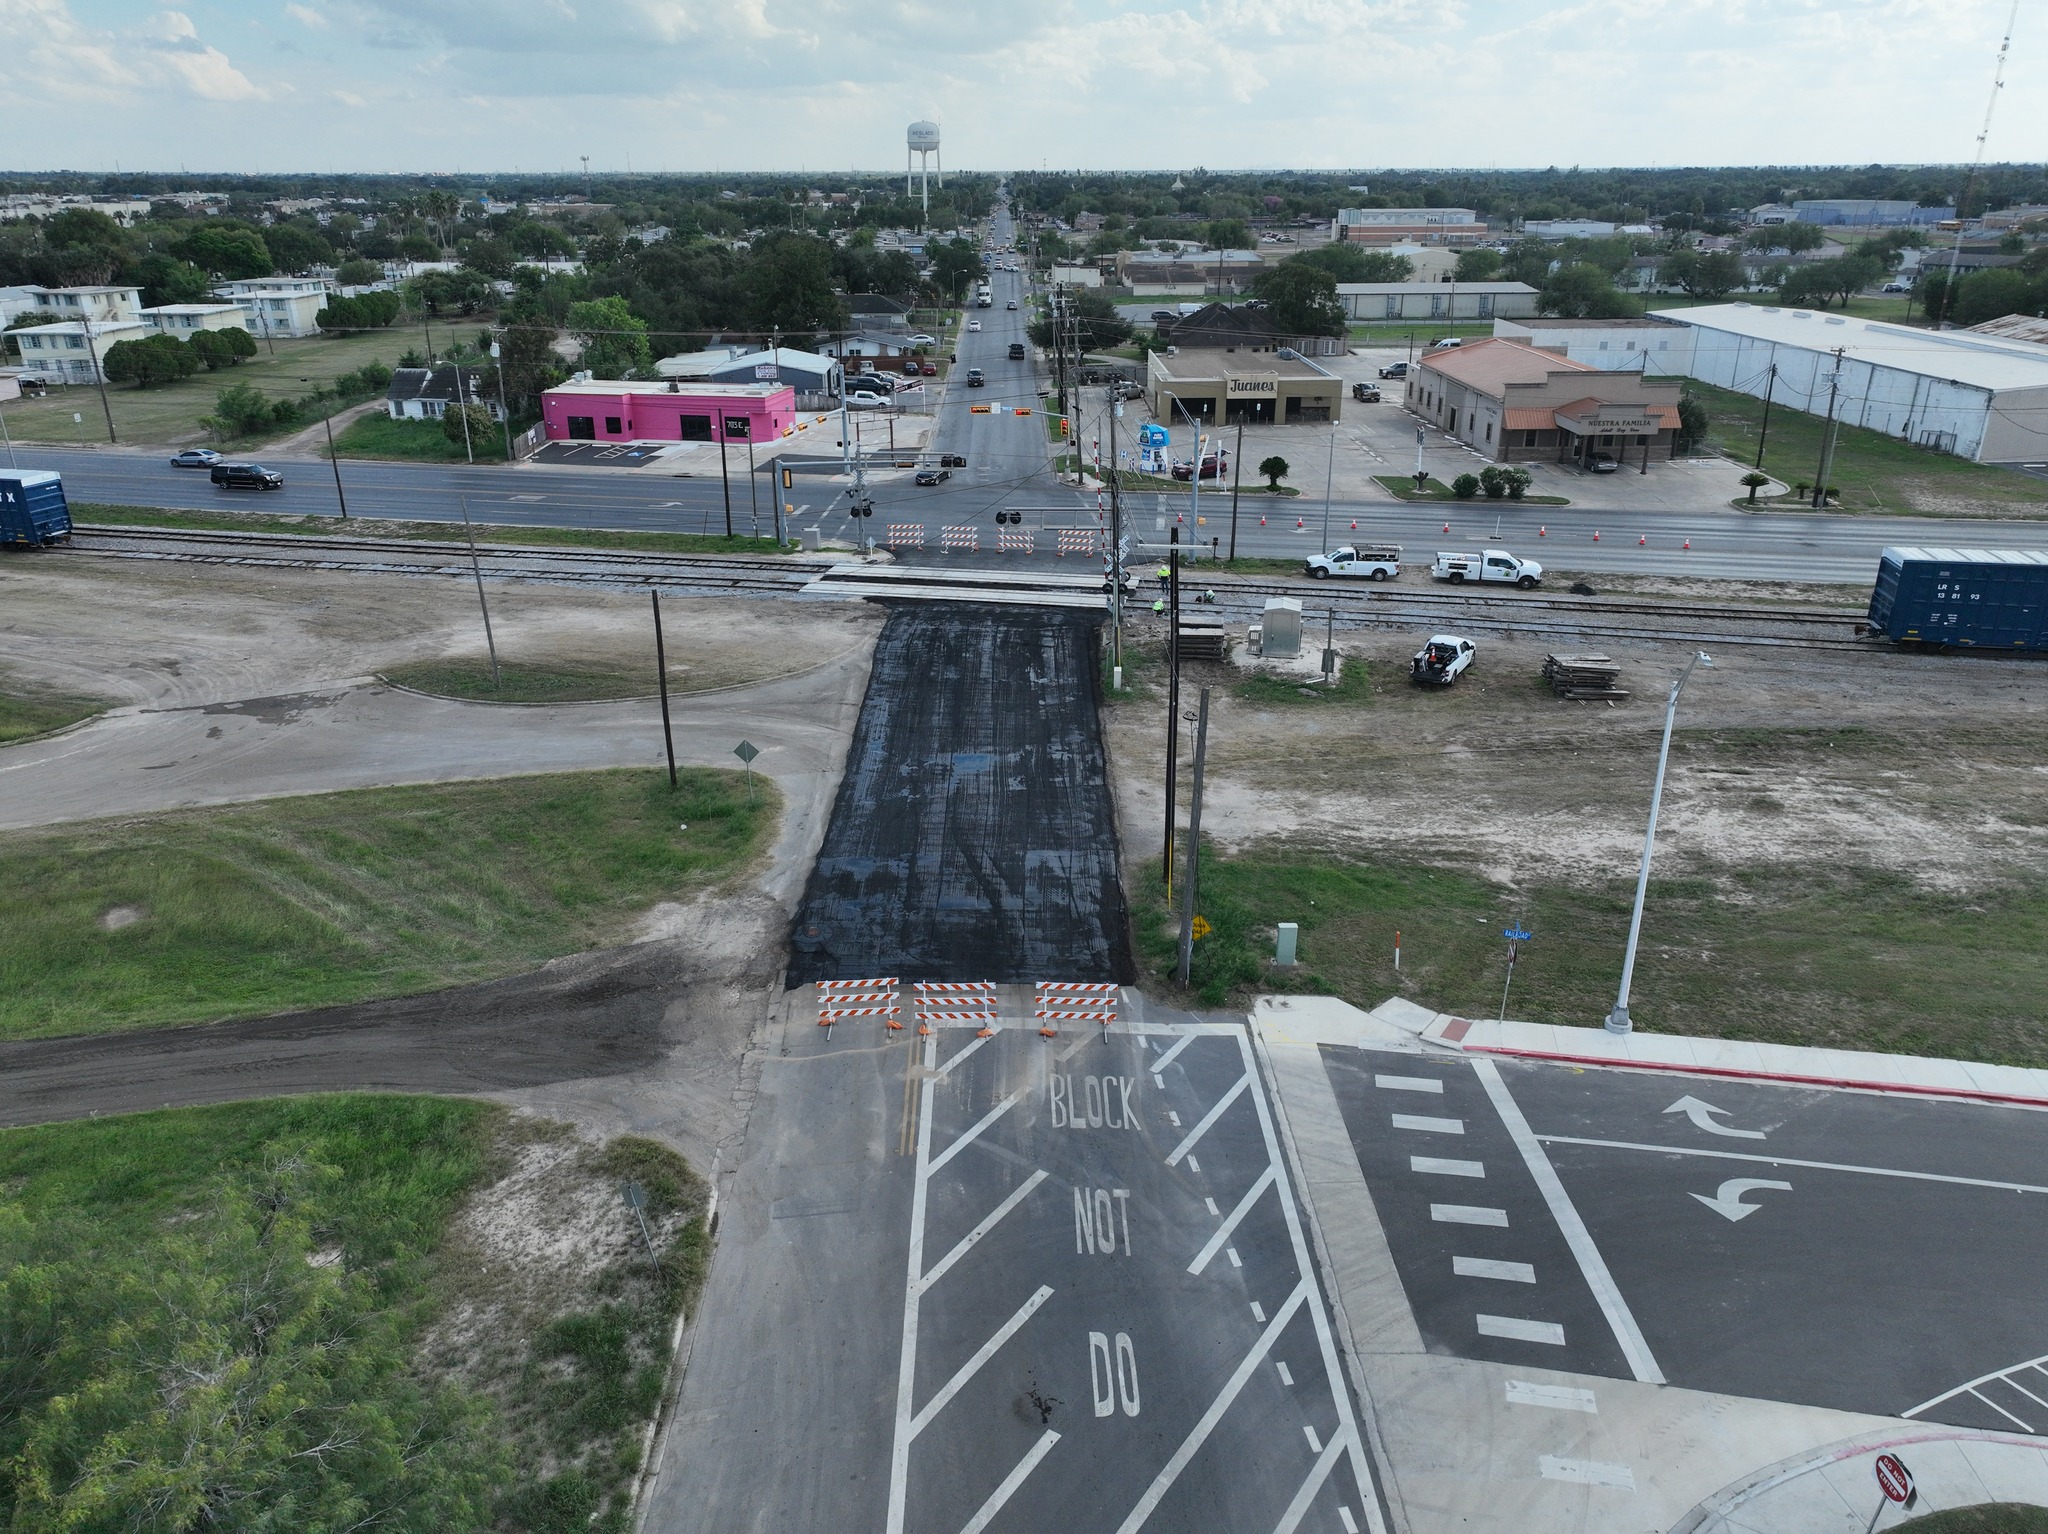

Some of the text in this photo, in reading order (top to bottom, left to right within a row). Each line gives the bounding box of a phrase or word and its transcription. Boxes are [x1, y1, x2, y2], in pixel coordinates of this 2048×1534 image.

[1230, 379, 1276, 393] Juanes
[1050, 1073, 1142, 1131] BLOCK
[1074, 1187, 1131, 1256] NOT
[1089, 1331, 1141, 1417] DO
[1879, 1472, 1898, 1498] ENTER
[1883, 1458, 1906, 1486] DO NOT
